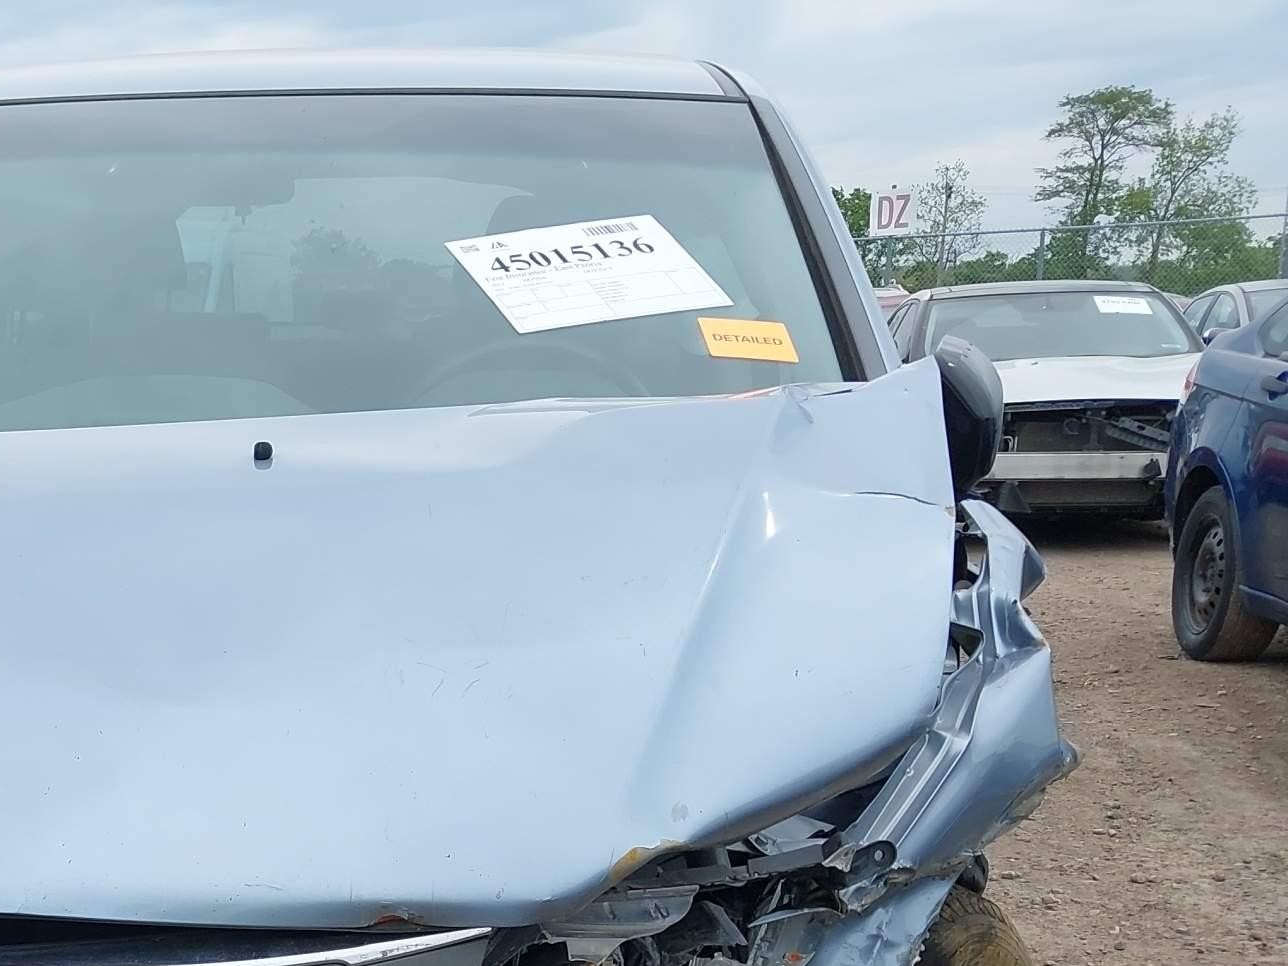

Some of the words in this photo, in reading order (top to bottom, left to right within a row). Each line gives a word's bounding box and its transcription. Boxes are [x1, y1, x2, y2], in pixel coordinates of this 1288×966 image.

[877, 194, 911, 230] DZ
[490, 236, 655, 273] 45015136
[711, 333, 784, 346] DETAILED
